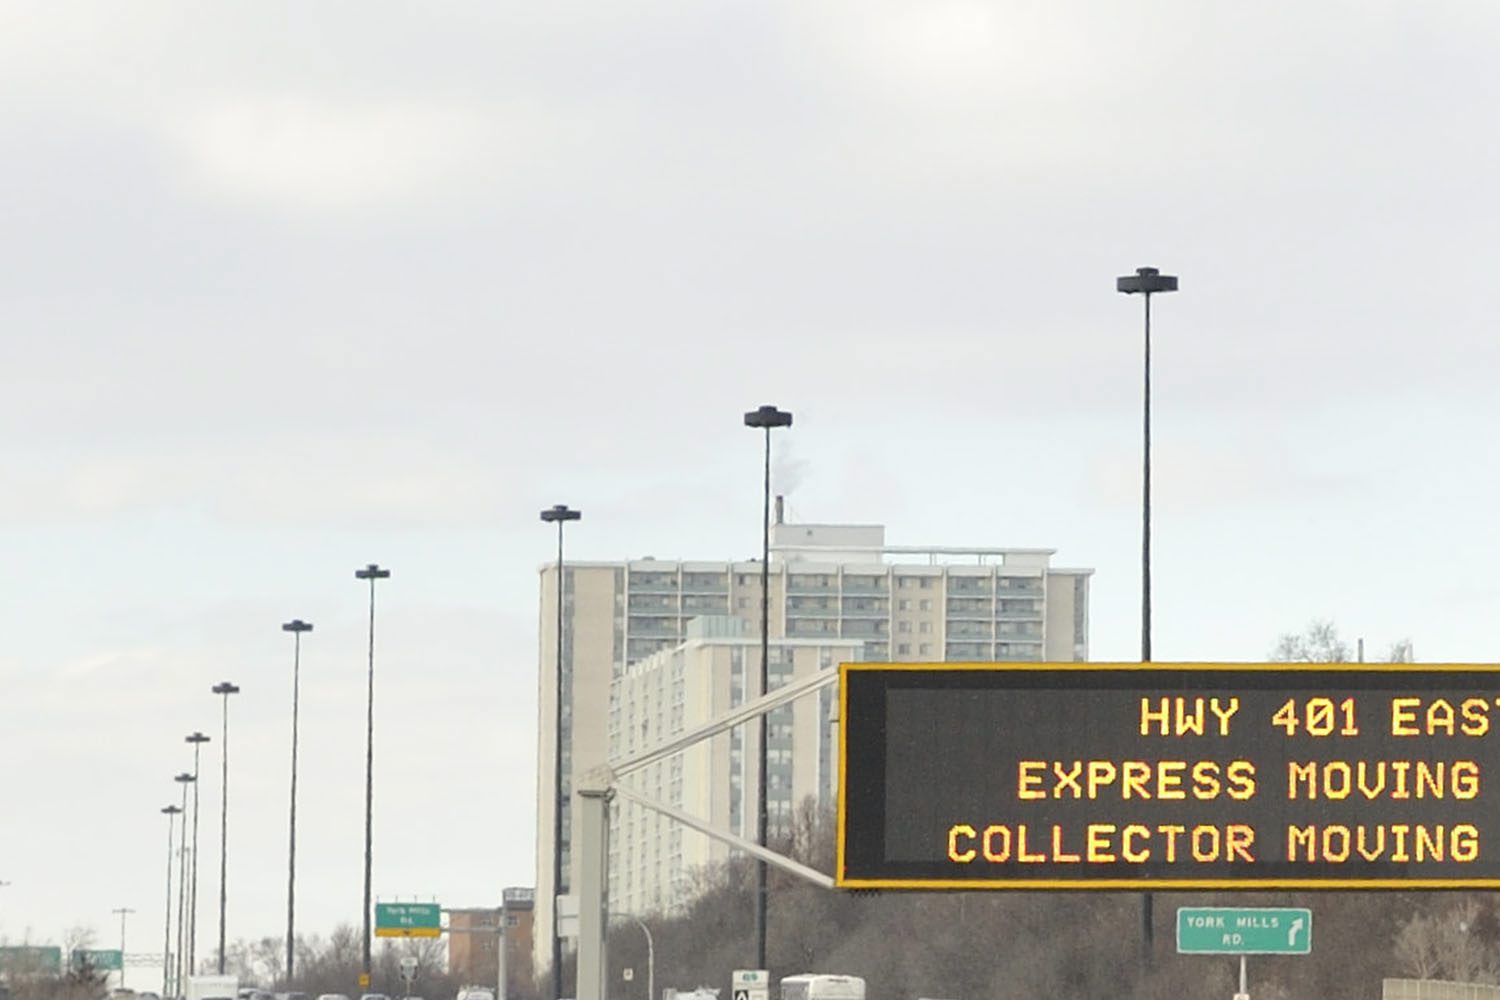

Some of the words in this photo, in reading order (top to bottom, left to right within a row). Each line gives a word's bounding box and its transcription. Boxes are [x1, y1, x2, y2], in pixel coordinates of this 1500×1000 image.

[1141, 697, 1238, 736] HWY
[1273, 697, 1358, 736] 401
[1018, 761, 1255, 799] EXPRESS
[1288, 761, 1479, 799] MOVING
[949, 824, 1254, 862] COLLECTOR
[1288, 825, 1478, 862] MOVING
[1187, 916, 1225, 929] YORK
[1236, 916, 1280, 929] MILLS
[1222, 933, 1245, 945] RD.
